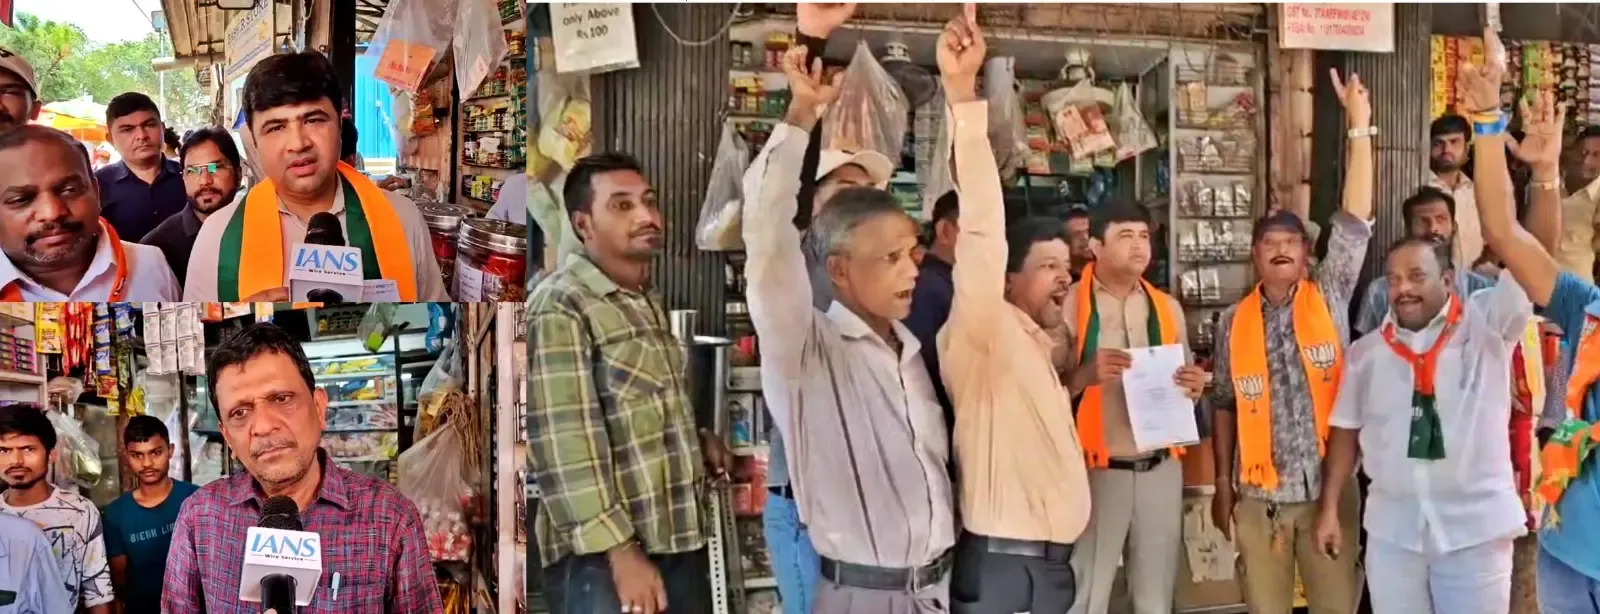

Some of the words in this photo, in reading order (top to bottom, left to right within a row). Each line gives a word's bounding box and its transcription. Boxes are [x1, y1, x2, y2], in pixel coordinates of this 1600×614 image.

[563, 13, 583, 26] only
[587, 7, 620, 20] Above
[590, 24, 609, 38] 100
[295, 248, 358, 271] IANS
[251, 533, 317, 557] IANS
